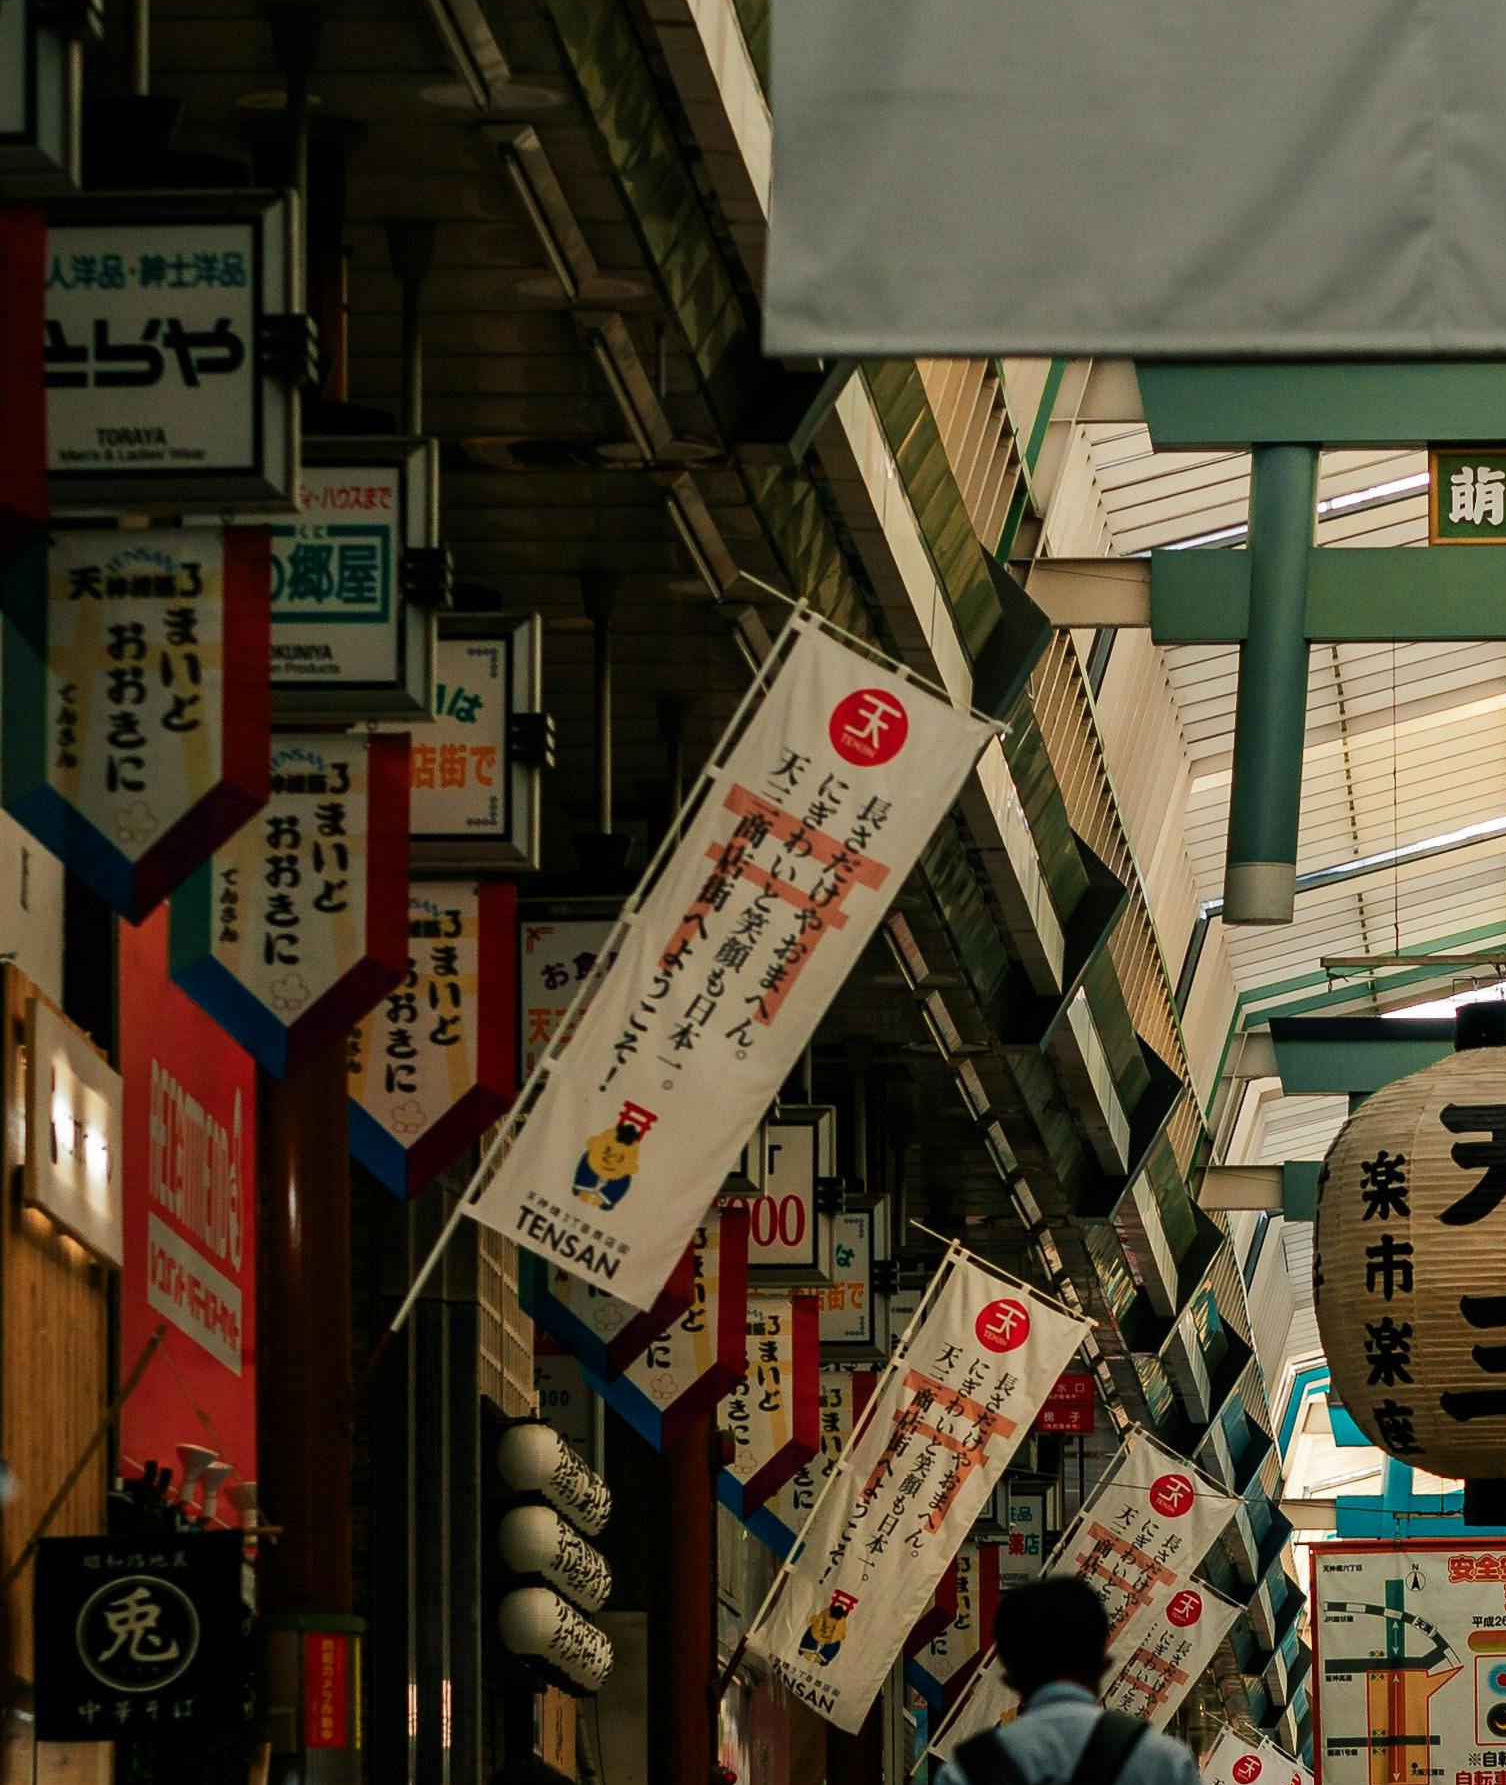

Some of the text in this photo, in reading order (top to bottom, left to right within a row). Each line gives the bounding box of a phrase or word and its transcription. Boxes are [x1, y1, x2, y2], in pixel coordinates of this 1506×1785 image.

[49, 253, 246, 290] 人洋品・紳士洋品
[97, 428, 167, 445] TORAYA
[107, 622, 147, 792] おおきに
[842, 692, 902, 749] 天
[264, 815, 301, 965] おおきに
[725, 793, 896, 1062] 長さだけやおまへん。
[657, 772, 852, 1092] にぎわいと笑顔も日本一。
[514, 1205, 621, 1282] TENSAN
[990, 1301, 1027, 1340] 天
[1360, 1149, 1427, 1456] 楽市楽座
[758, 1340, 781, 1413] まいど
[857, 1357, 991, 1584] にぎわいと笑顔も日本一。
[904, 1371, 1020, 1560] 長さだけやおまへん。
[1161, 1476, 1191, 1507] 天
[1007, 1532, 1040, 1556] 薬店
